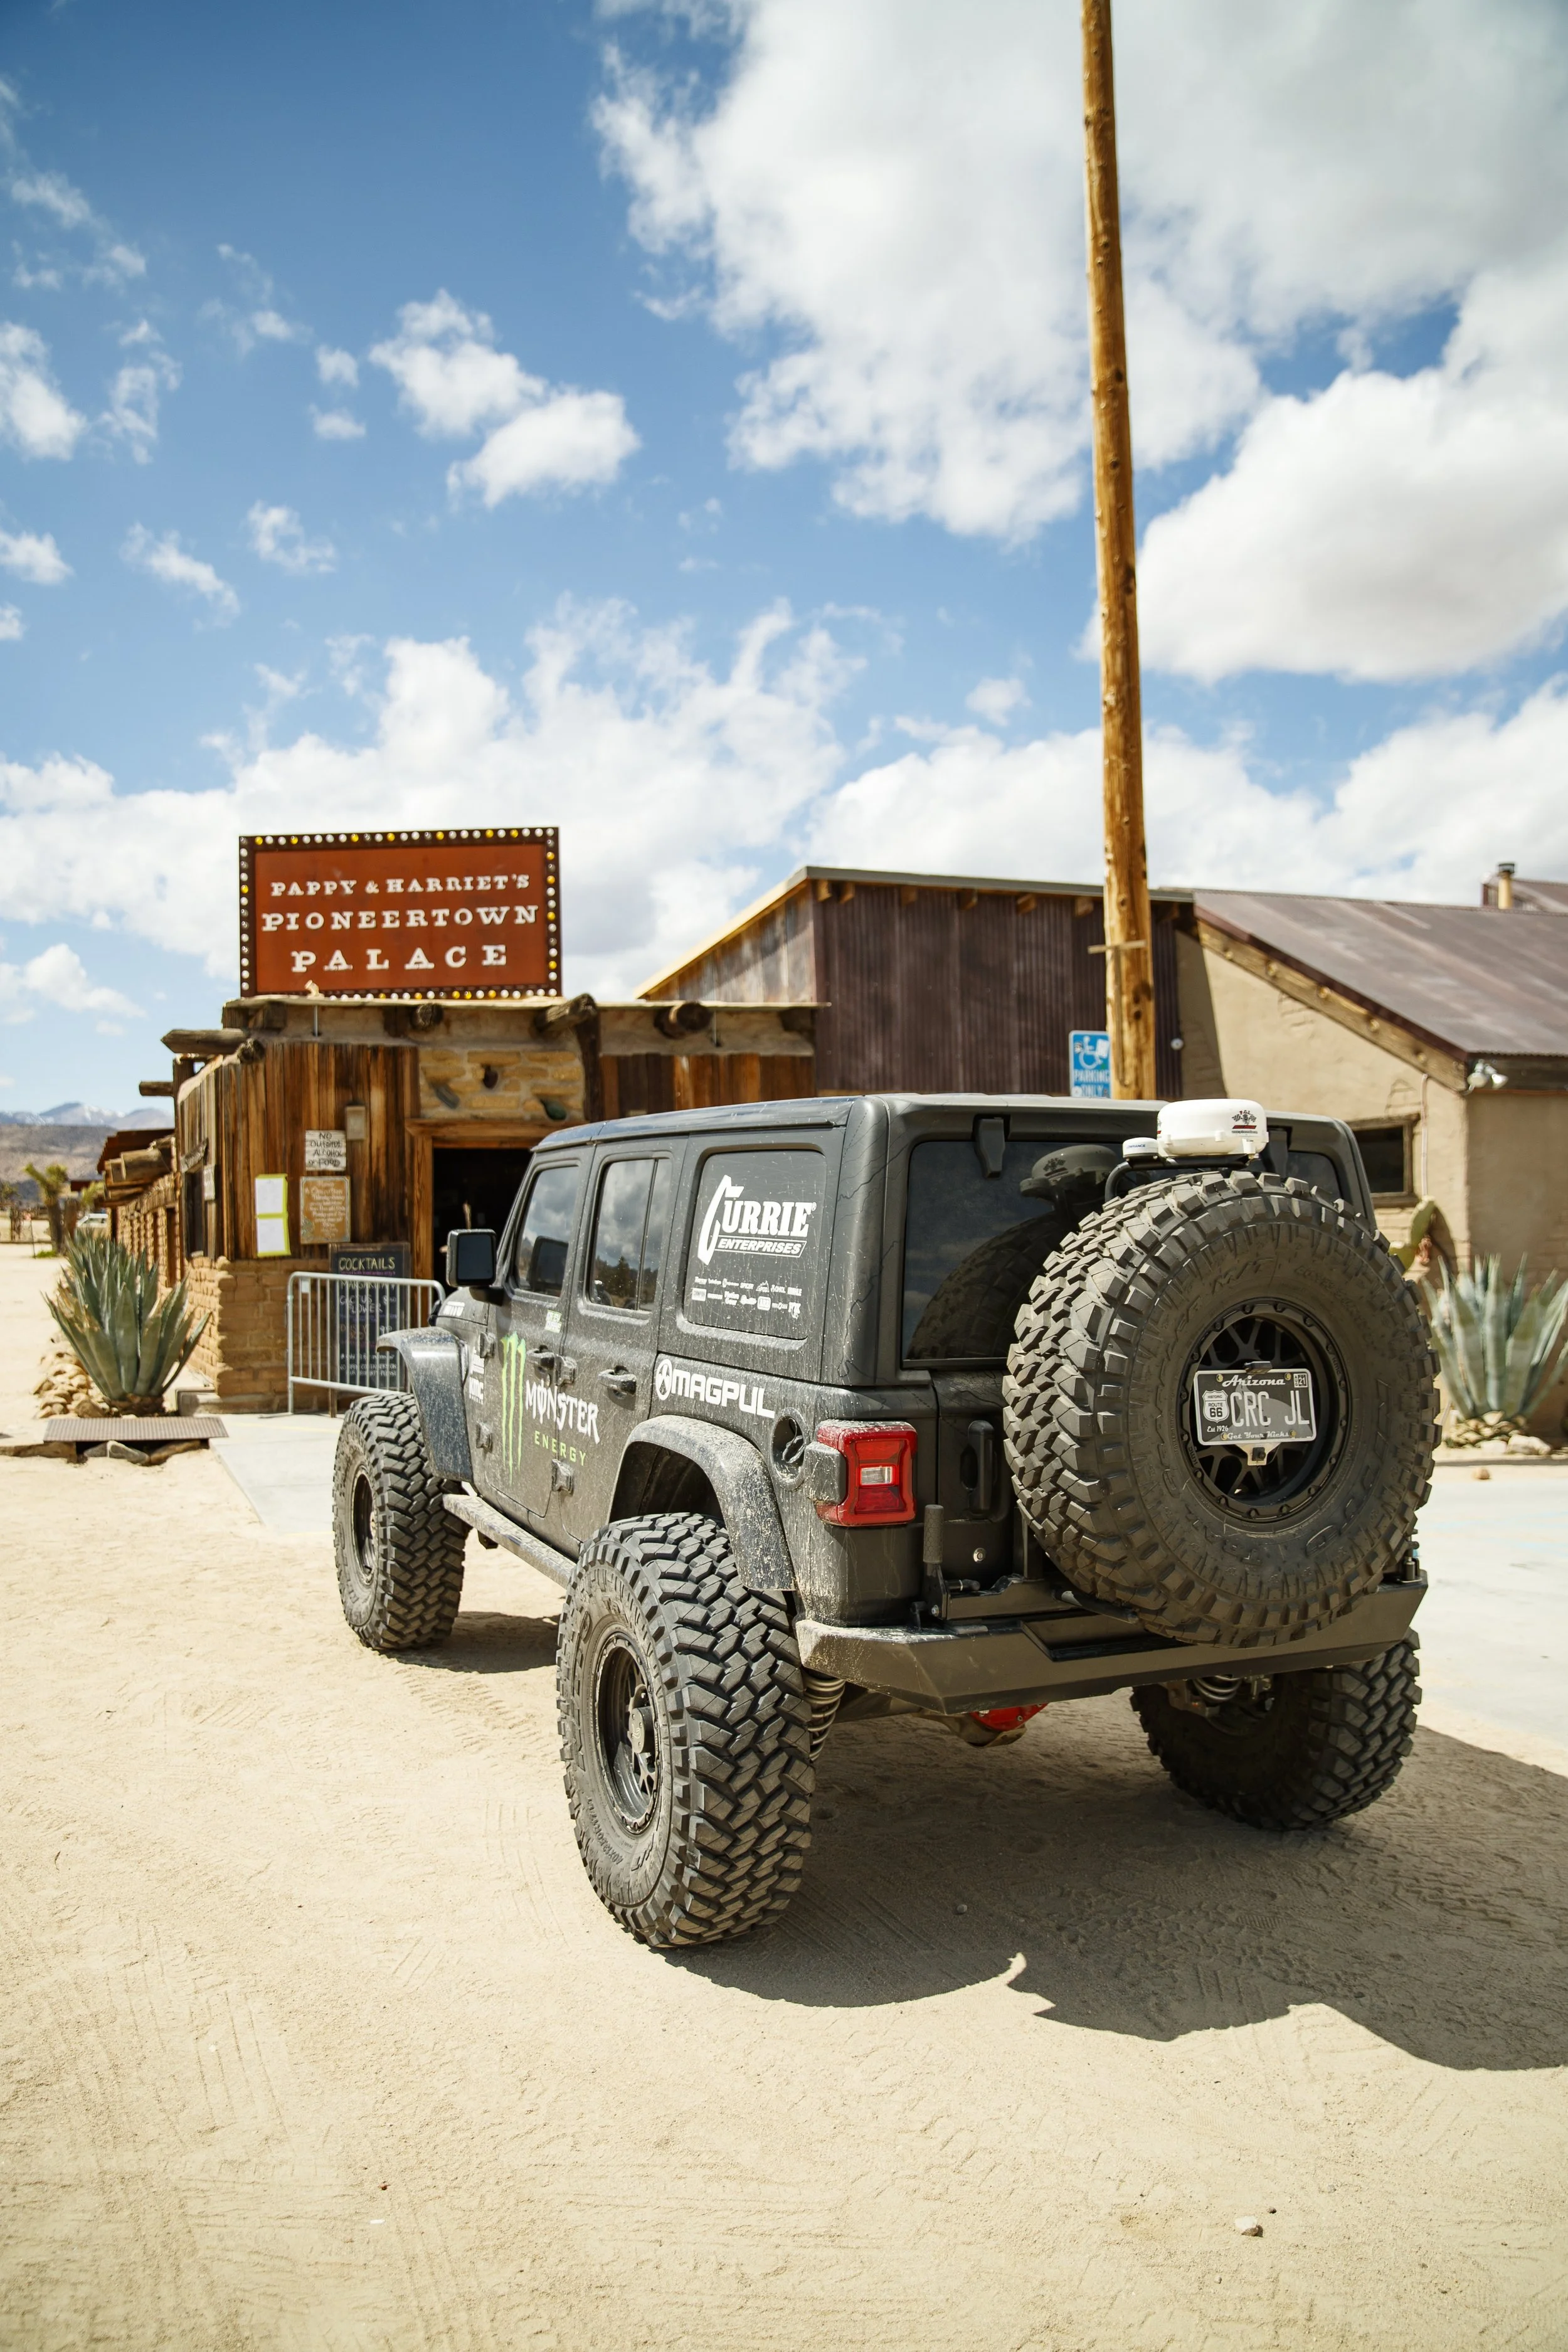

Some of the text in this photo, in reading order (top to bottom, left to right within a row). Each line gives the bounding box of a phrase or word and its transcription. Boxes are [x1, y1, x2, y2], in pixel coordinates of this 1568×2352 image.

[270, 874, 530, 897] PAPPY & HARRIET'S
[262, 904, 538, 932] PIONEERTOWN
[290, 944, 507, 973] PALACE
[319, 1132, 332, 1140] NO
[718, 1238, 803, 1255] ENTERPRISES
[339, 1257, 395, 1271] COCKTAILS
[1222, 1375, 1286, 1387] Arizona
[1298, 1377, 1306, 1385] 21
[671, 1367, 775, 1419] MAGPUL
[524, 1379, 601, 1444] MONSTER
[1209, 1407, 1223, 1417] 66
[1230, 1390, 1310, 1427] CRC JL
[1227, 1432, 1242, 1440] Get
[534, 1430, 587, 1466] ENERGY
